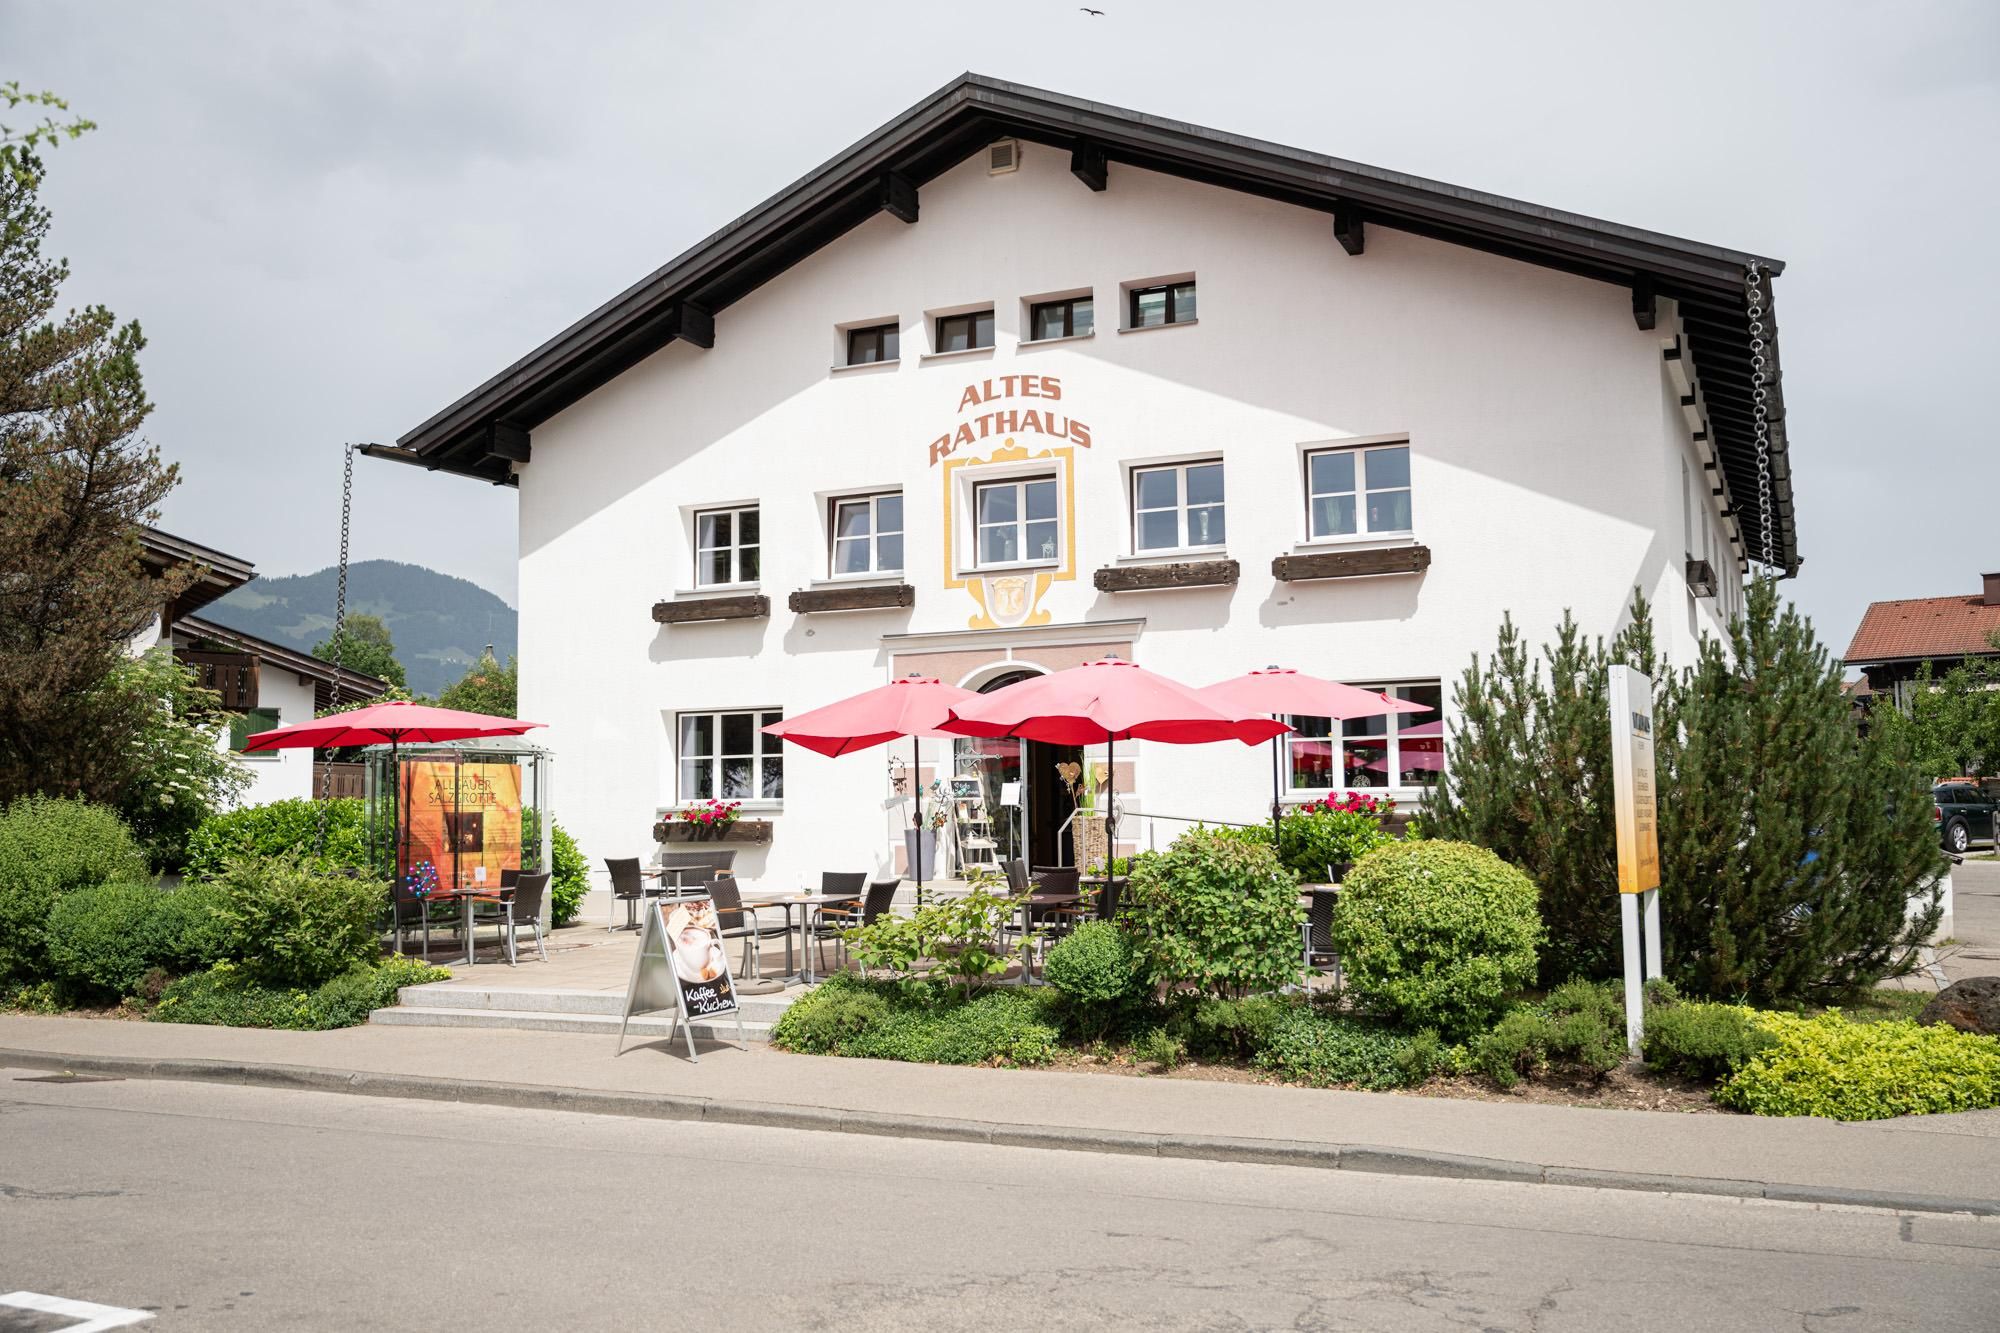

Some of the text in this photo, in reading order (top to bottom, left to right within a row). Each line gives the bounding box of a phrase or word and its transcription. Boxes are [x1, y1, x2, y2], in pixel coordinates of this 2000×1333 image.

[957, 375, 1061, 413] ALTES
[929, 409, 1091, 467] RATHAUS
[685, 986, 717, 1001] Kaffee
[699, 998, 734, 1013] Kuchen
